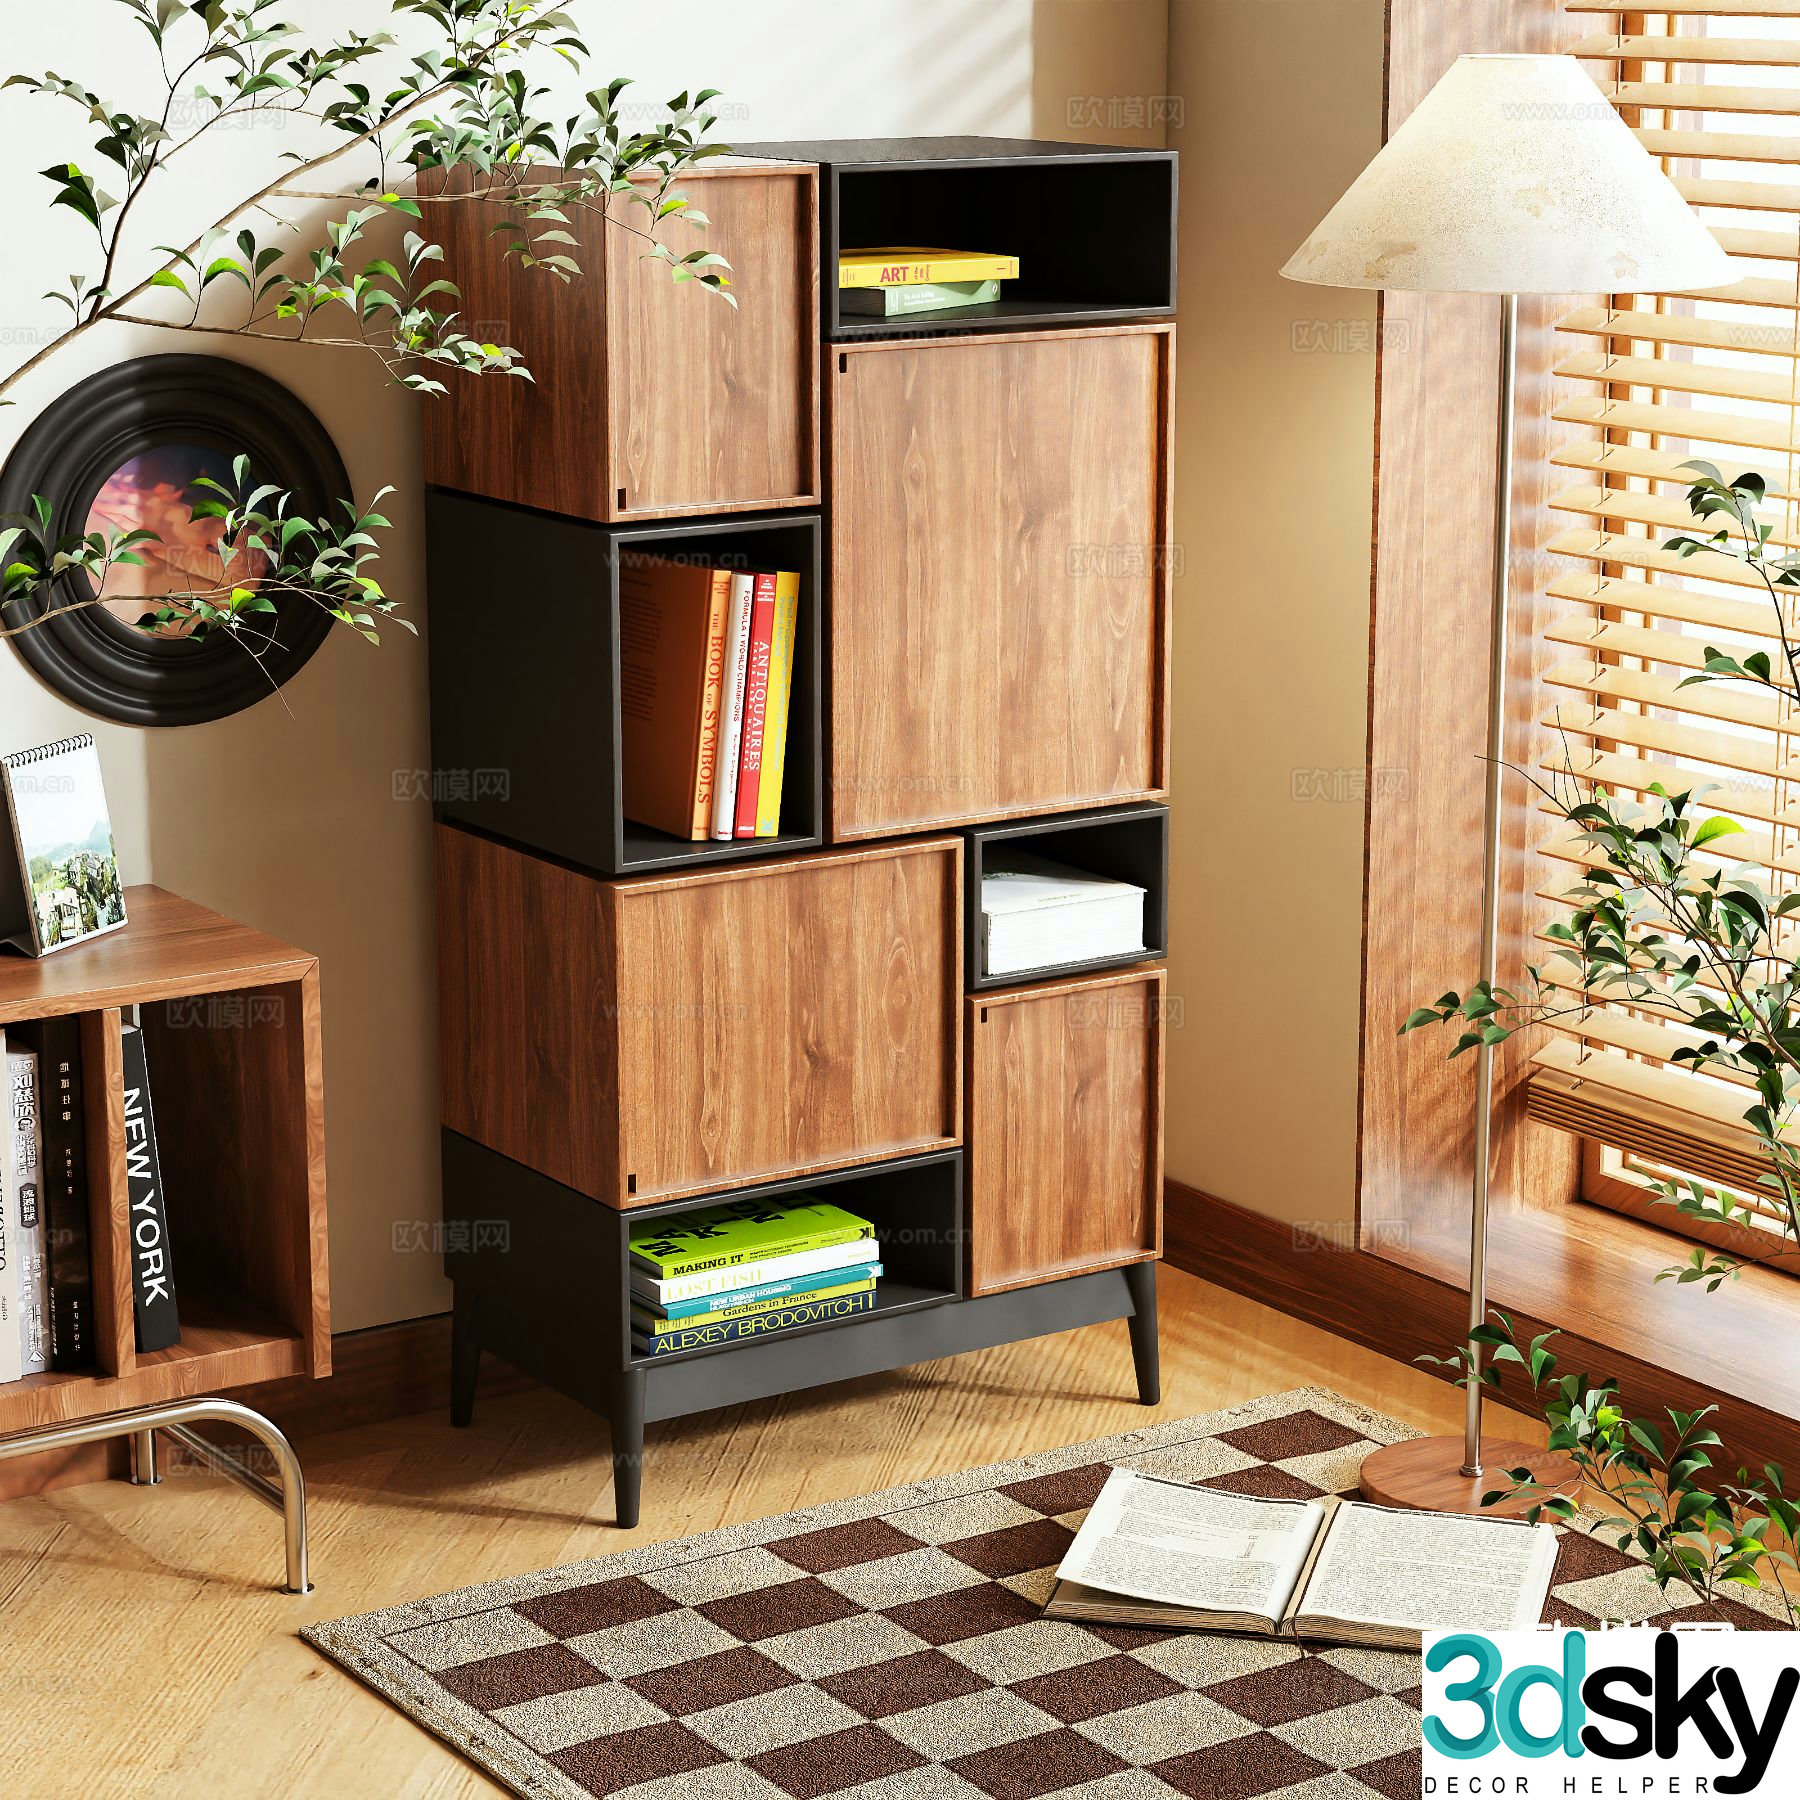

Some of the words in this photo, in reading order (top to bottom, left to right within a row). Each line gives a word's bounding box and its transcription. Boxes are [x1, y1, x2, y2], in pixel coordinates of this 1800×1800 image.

[880, 266, 909, 283] ART
[742, 590, 751, 632] FORMULA
[707, 636, 723, 689] BOOK
[737, 640, 747, 671] WORLD
[707, 693, 712, 706] OF
[733, 672, 744, 722] CHAMPIONS
[749, 641, 770, 771] ANTIQUAIRES
[698, 709, 718, 804] SYMBOLS
[123, 1087, 152, 1179] NEW
[22, 1189, 35, 1222] 流浪地球
[131, 1188, 169, 1307] YORK
[672, 1256, 727, 1276] MAKING
[730, 1253, 744, 1264] IT
[667, 1278, 716, 1300] LOST
[722, 1268, 762, 1289] FISH
[730, 1292, 755, 1304] URBAN
[756, 1284, 792, 1296] HOUSING
[722, 1302, 767, 1318] Gardens
[769, 1298, 779, 1308] in
[782, 1292, 817, 1306] France
[654, 1322, 735, 1354] ALEXEY
[738, 1295, 863, 1337] BRODOVITCH
